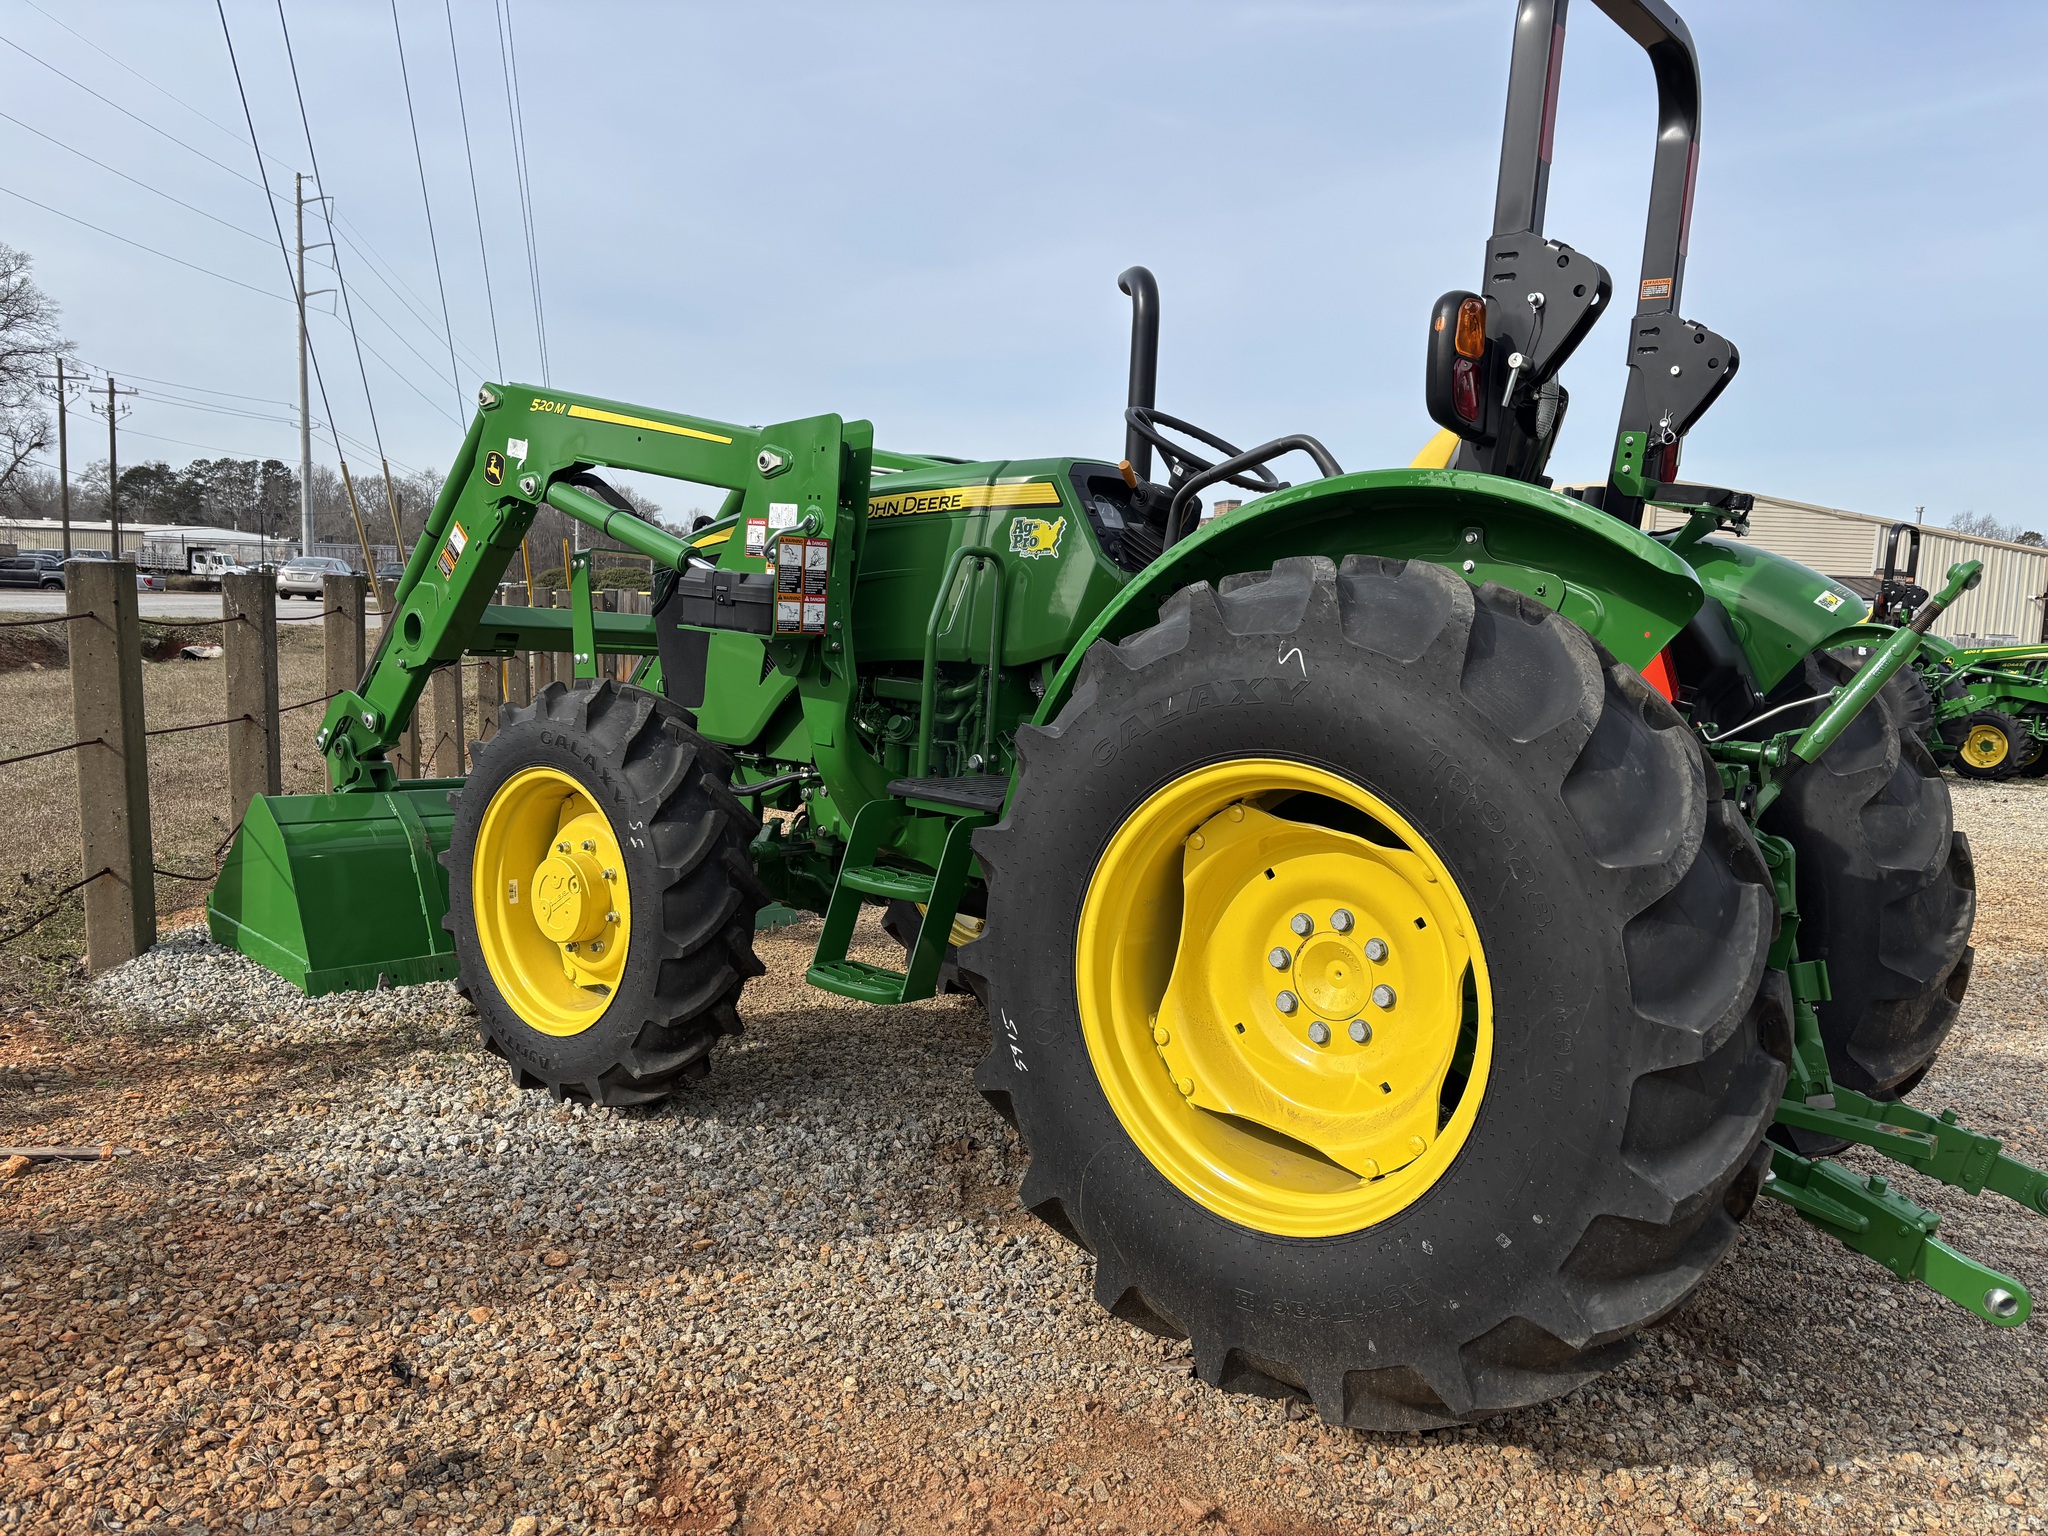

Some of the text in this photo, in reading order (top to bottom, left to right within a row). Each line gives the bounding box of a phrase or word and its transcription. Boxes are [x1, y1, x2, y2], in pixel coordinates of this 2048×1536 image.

[868, 494, 962, 516] OHN DEERE
[1012, 535, 1038, 549] Pro
[1091, 676, 1312, 768] GALAXY
[540, 730, 628, 806] GALAXY
